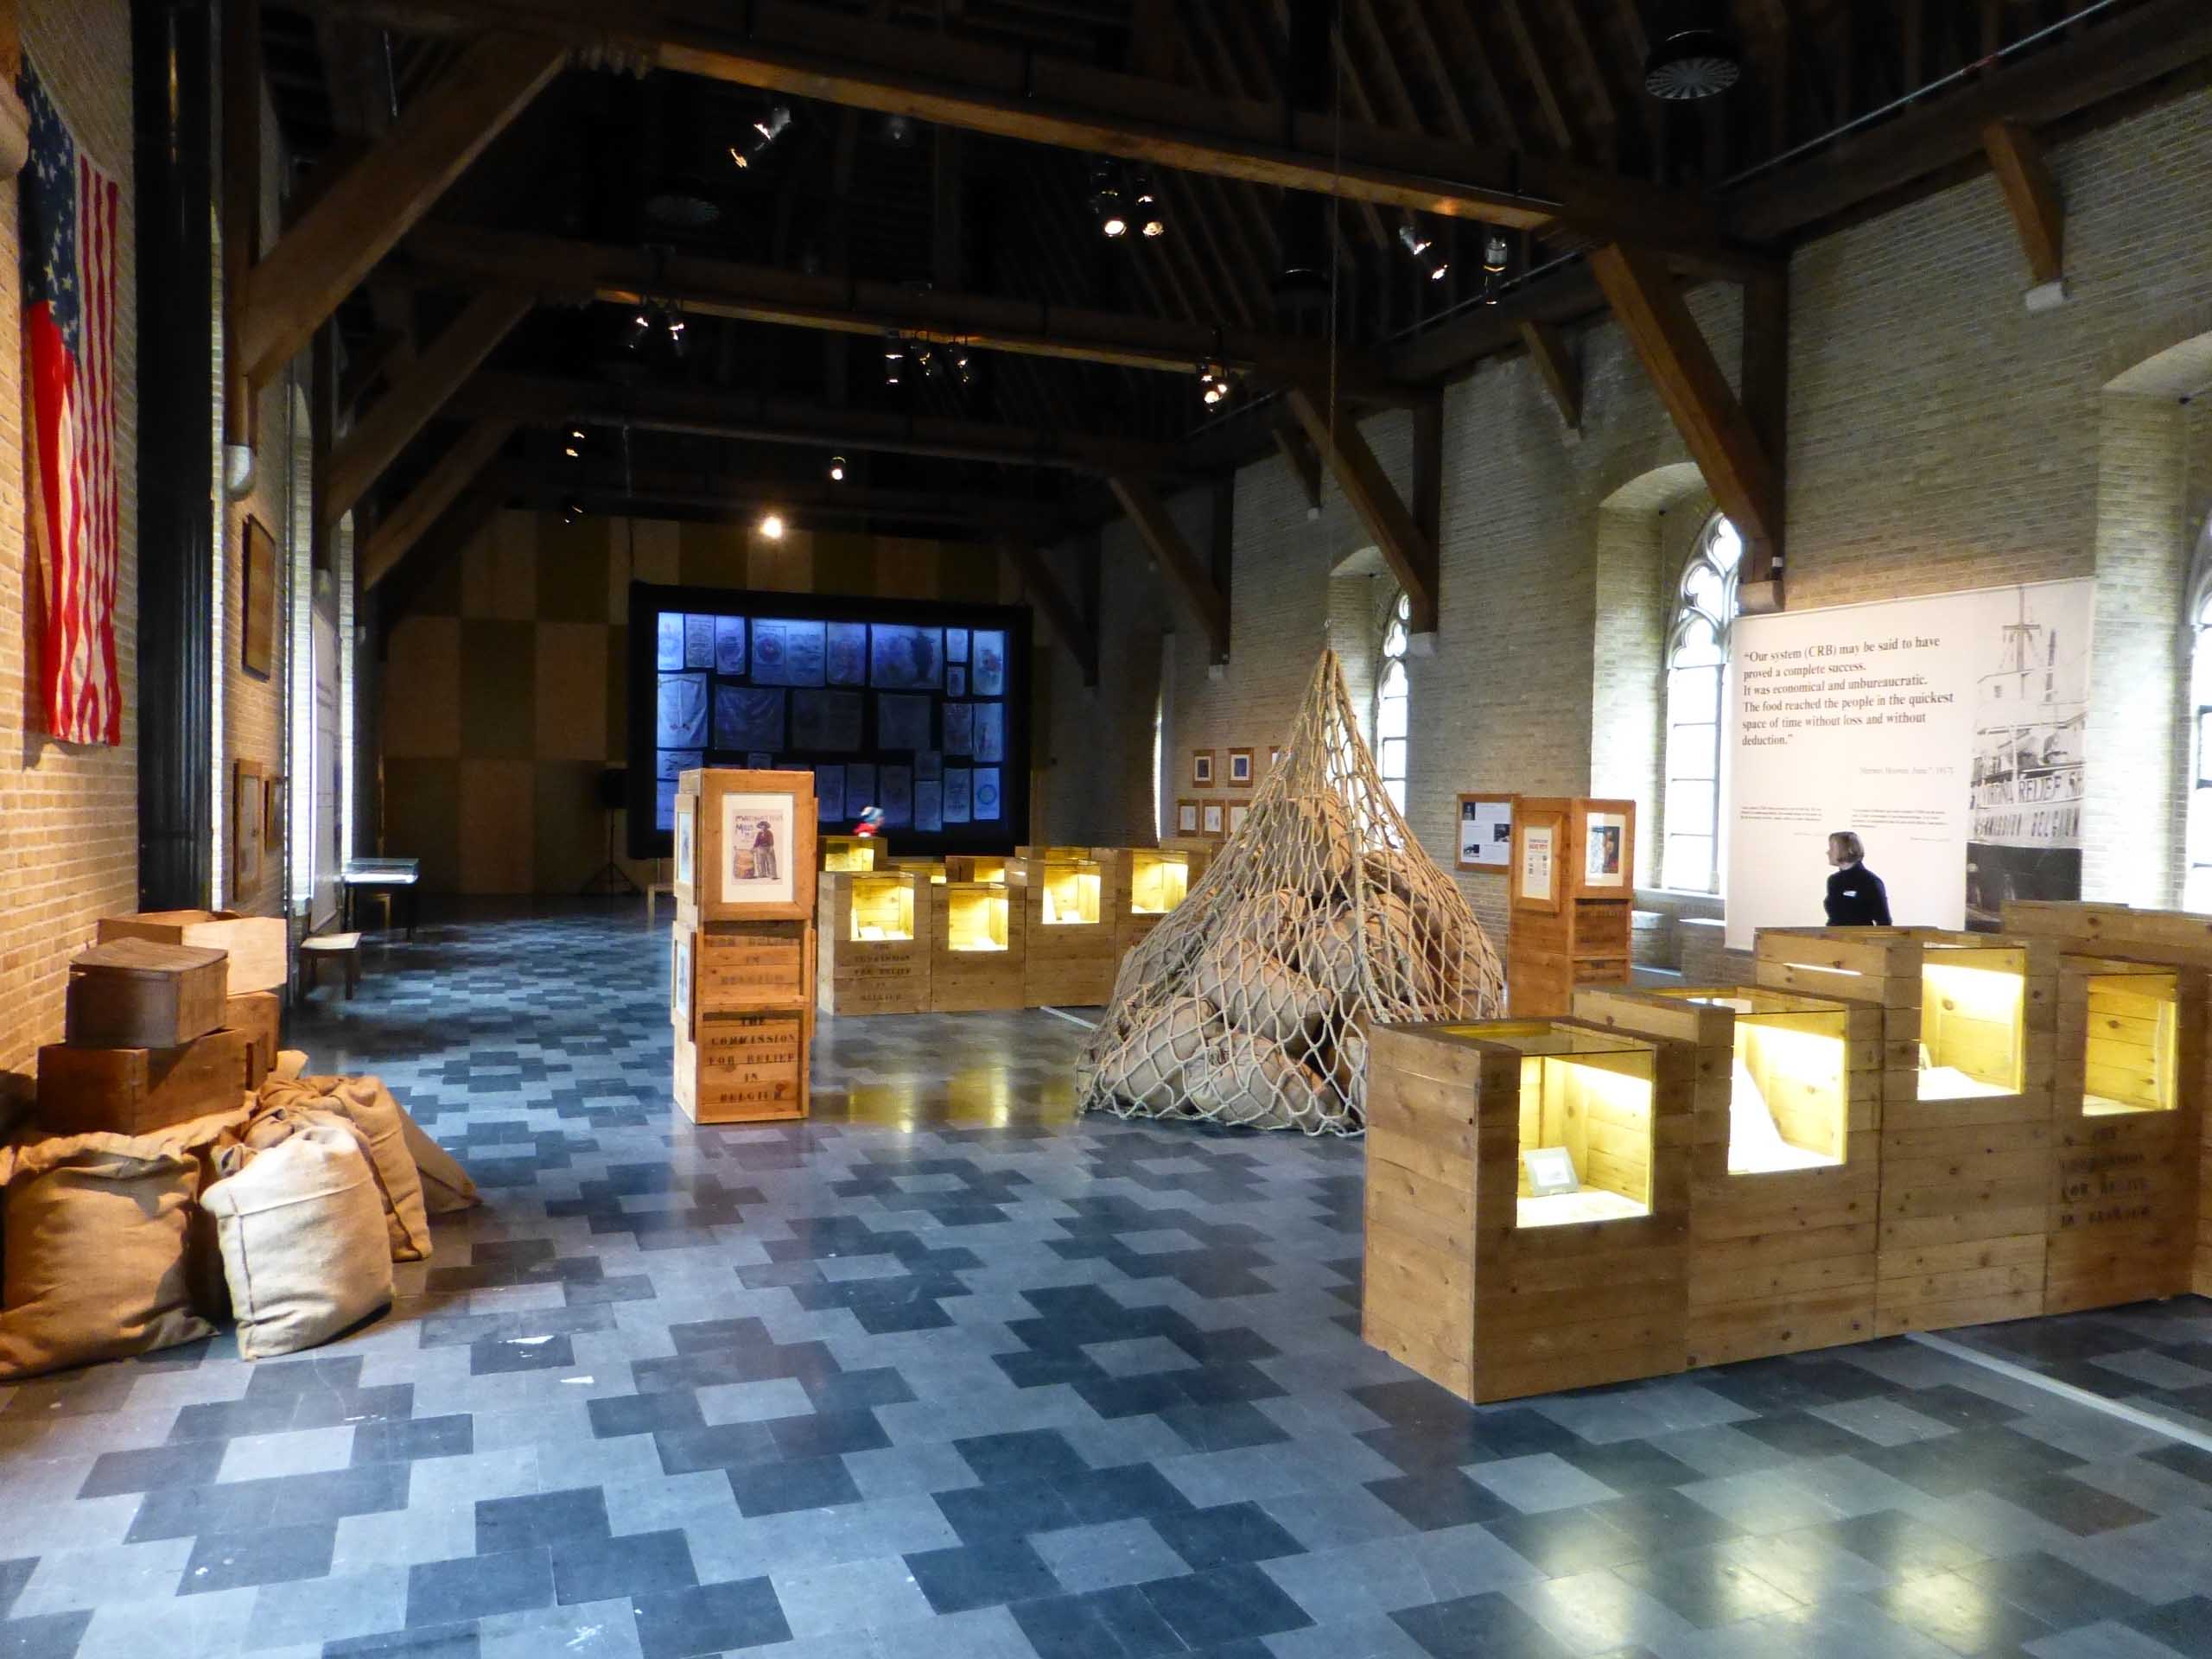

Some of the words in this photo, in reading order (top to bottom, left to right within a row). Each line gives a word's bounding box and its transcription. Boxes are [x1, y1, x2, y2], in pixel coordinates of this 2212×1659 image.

[1770, 649, 1802, 664] system
[1804, 644, 1837, 660] (CRB)
[1840, 645, 1859, 658] may
[1864, 641, 1875, 652] be
[1878, 637, 1898, 651] said
[1902, 639, 1912, 649] to
[1915, 636, 1941, 648] have
[1744, 666, 1772, 683] proved
[1783, 664, 1826, 678] complete
[1828, 662, 1866, 673] success.
[1744, 685, 1751, 696] It
[1754, 686, 1770, 695] was
[1772, 680, 1826, 694] economical
[1827, 678, 1846, 691] and
[1848, 673, 1929, 690] unbureaucratic.
[1744, 701, 1760, 713] The
[1763, 699, 1783, 711] food
[1785, 698, 1821, 710] reached
[1824, 697, 1840, 709] the
[1841, 695, 1874, 711] people
[1877, 694, 1885, 706] in
[1889, 693, 1905, 705] the
[1909, 690, 1955, 708] quickest
[1742, 718, 1767, 732] space
[1769, 716, 1779, 728] of
[1782, 716, 1802, 728] time
[1805, 715, 1840, 727] without
[1843, 714, 1863, 726] loss
[1866, 712, 1883, 725] and
[1886, 711, 1926, 724] without
[711, 1033, 795, 1046] COMMISSION
[708, 1056, 734, 1066] FOR
[747, 1052, 795, 1065] RELIEF
